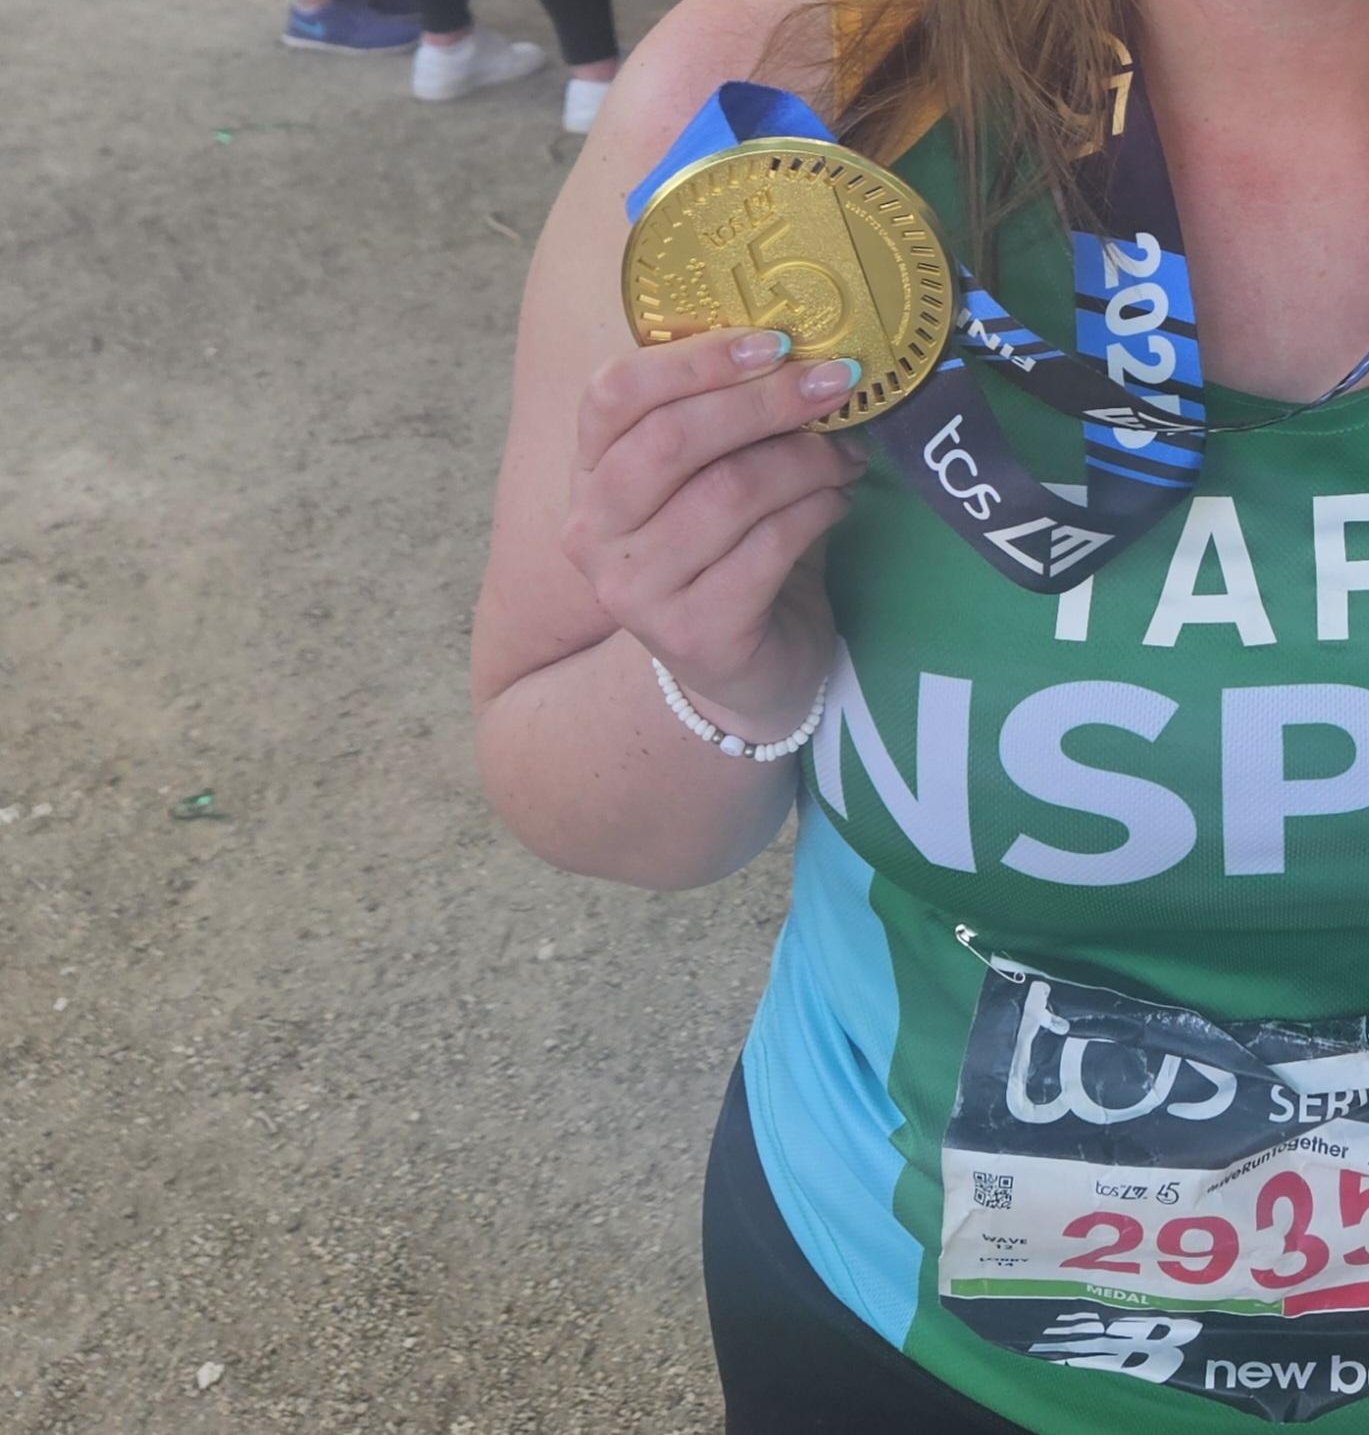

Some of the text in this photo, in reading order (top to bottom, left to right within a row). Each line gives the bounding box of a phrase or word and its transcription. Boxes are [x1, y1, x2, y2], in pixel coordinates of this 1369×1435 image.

[982, 1233, 1028, 1245] WAVE
[1086, 1284, 1150, 1306] MEDAL
[1205, 1359, 1317, 1390] new
